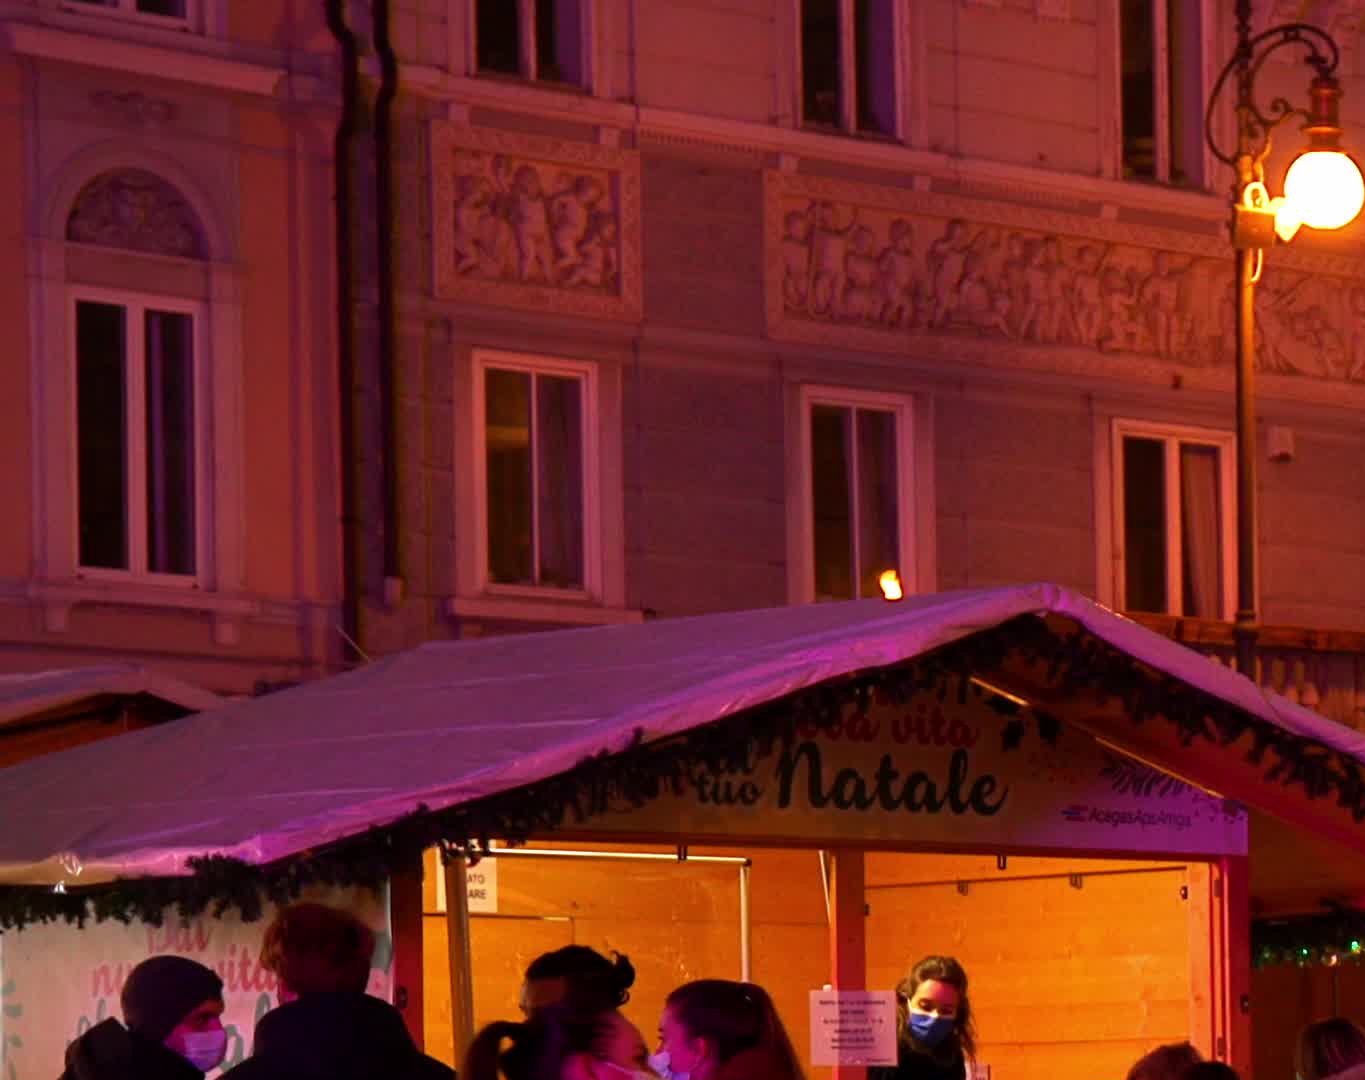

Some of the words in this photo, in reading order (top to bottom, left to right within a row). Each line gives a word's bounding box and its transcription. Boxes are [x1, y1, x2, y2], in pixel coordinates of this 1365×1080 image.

[891, 702, 978, 747] vita
[695, 769, 764, 806] tuo
[776, 741, 1008, 815] Natale
